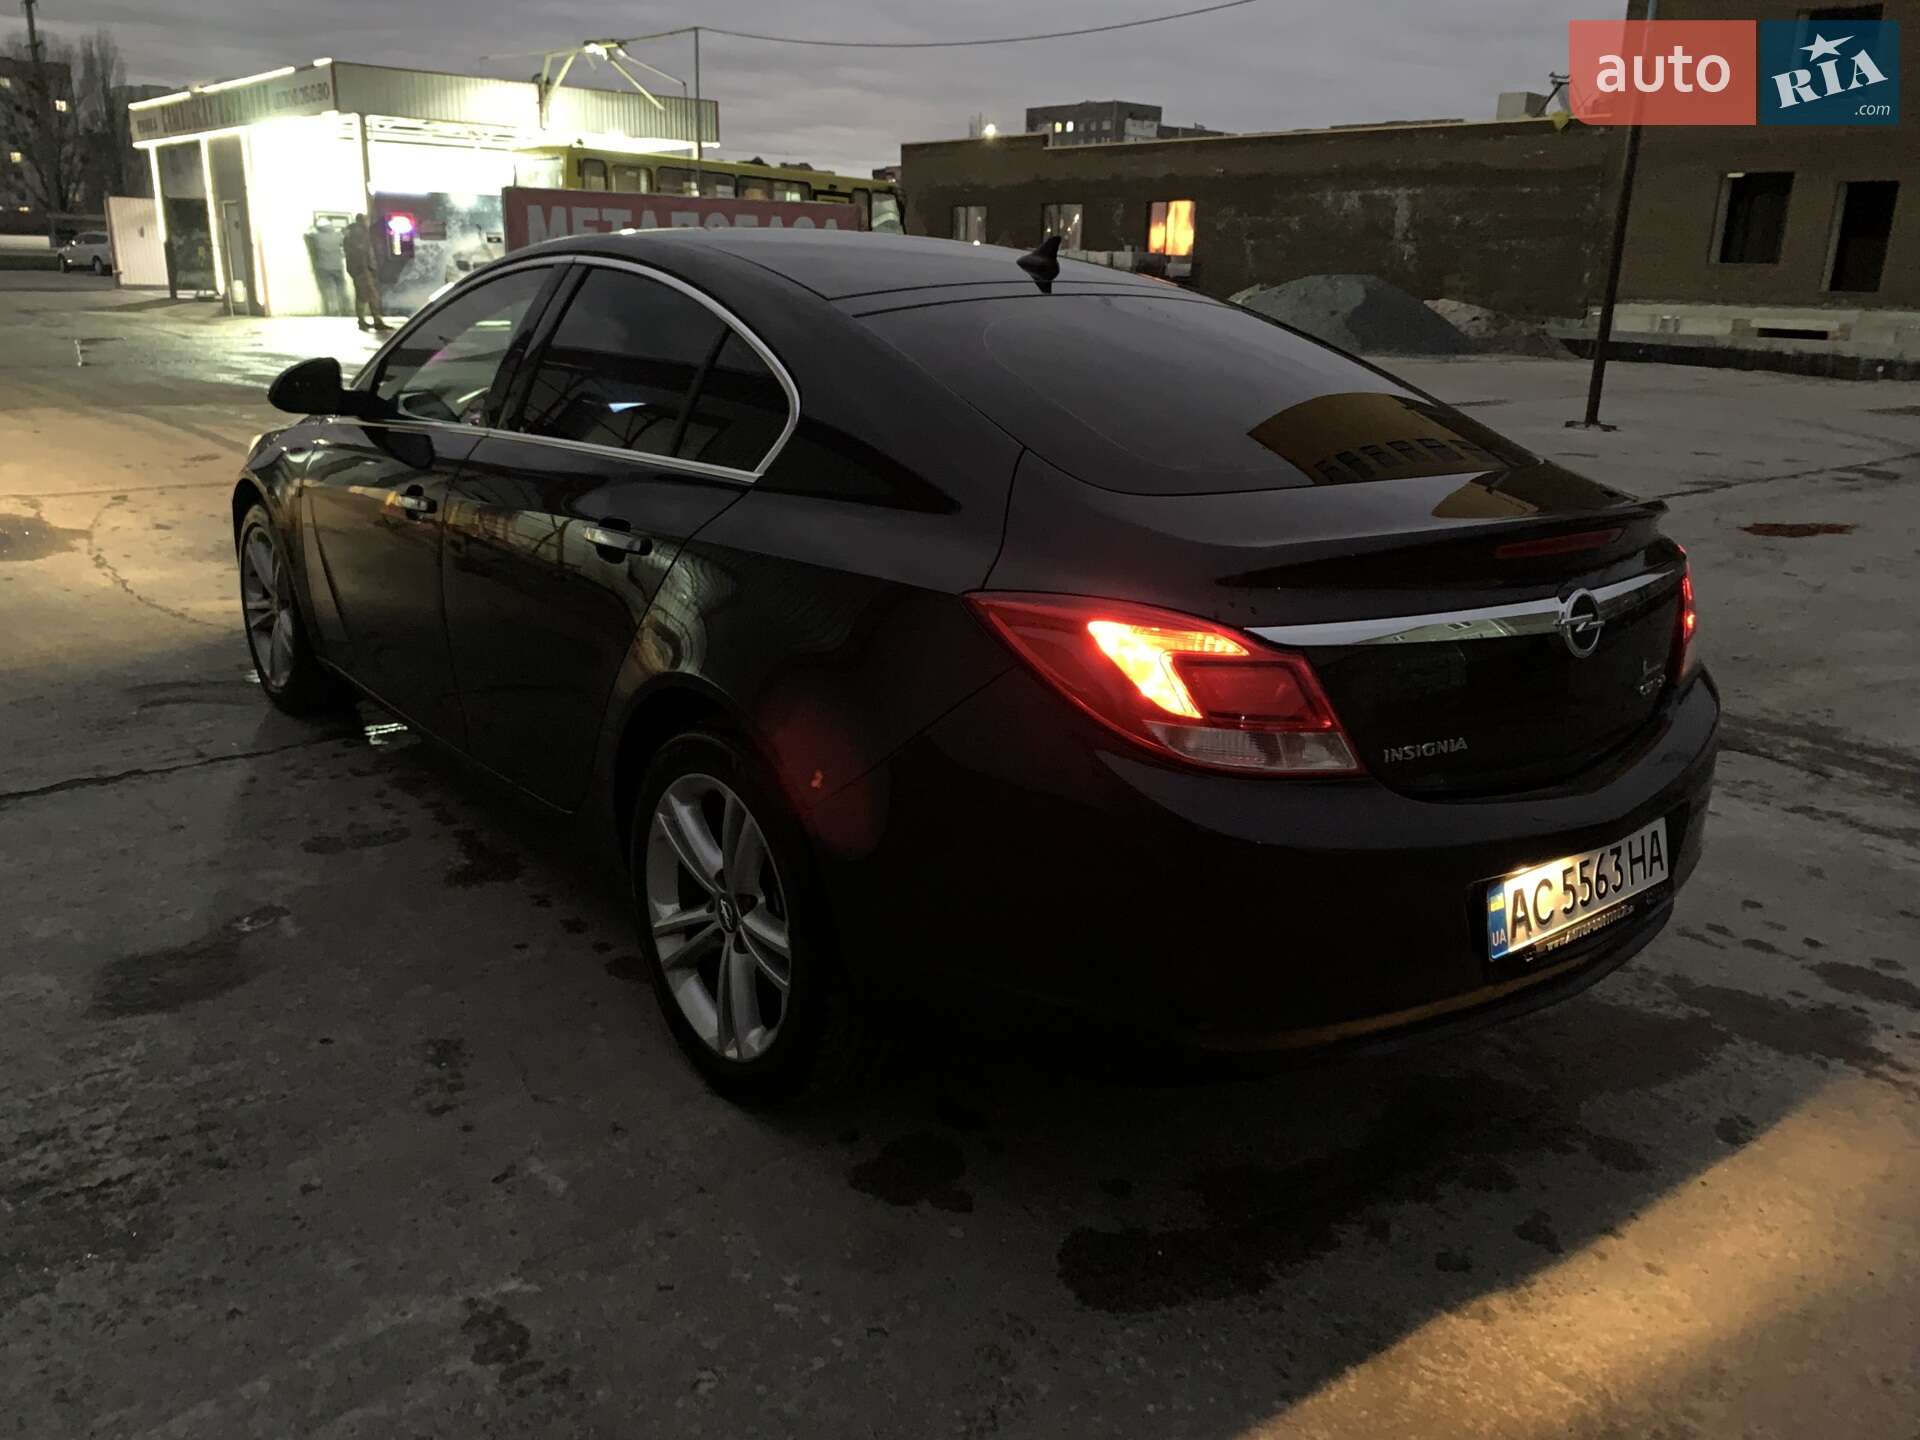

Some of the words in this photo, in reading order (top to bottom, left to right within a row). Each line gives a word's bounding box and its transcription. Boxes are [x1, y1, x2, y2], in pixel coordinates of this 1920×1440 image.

[1383, 736, 1468, 764] INSIGNIA
[1510, 878, 1554, 942] AC
[1562, 845, 1624, 915] 5563
[1629, 830, 1665, 886] HA
[1492, 928, 1507, 947] UA
